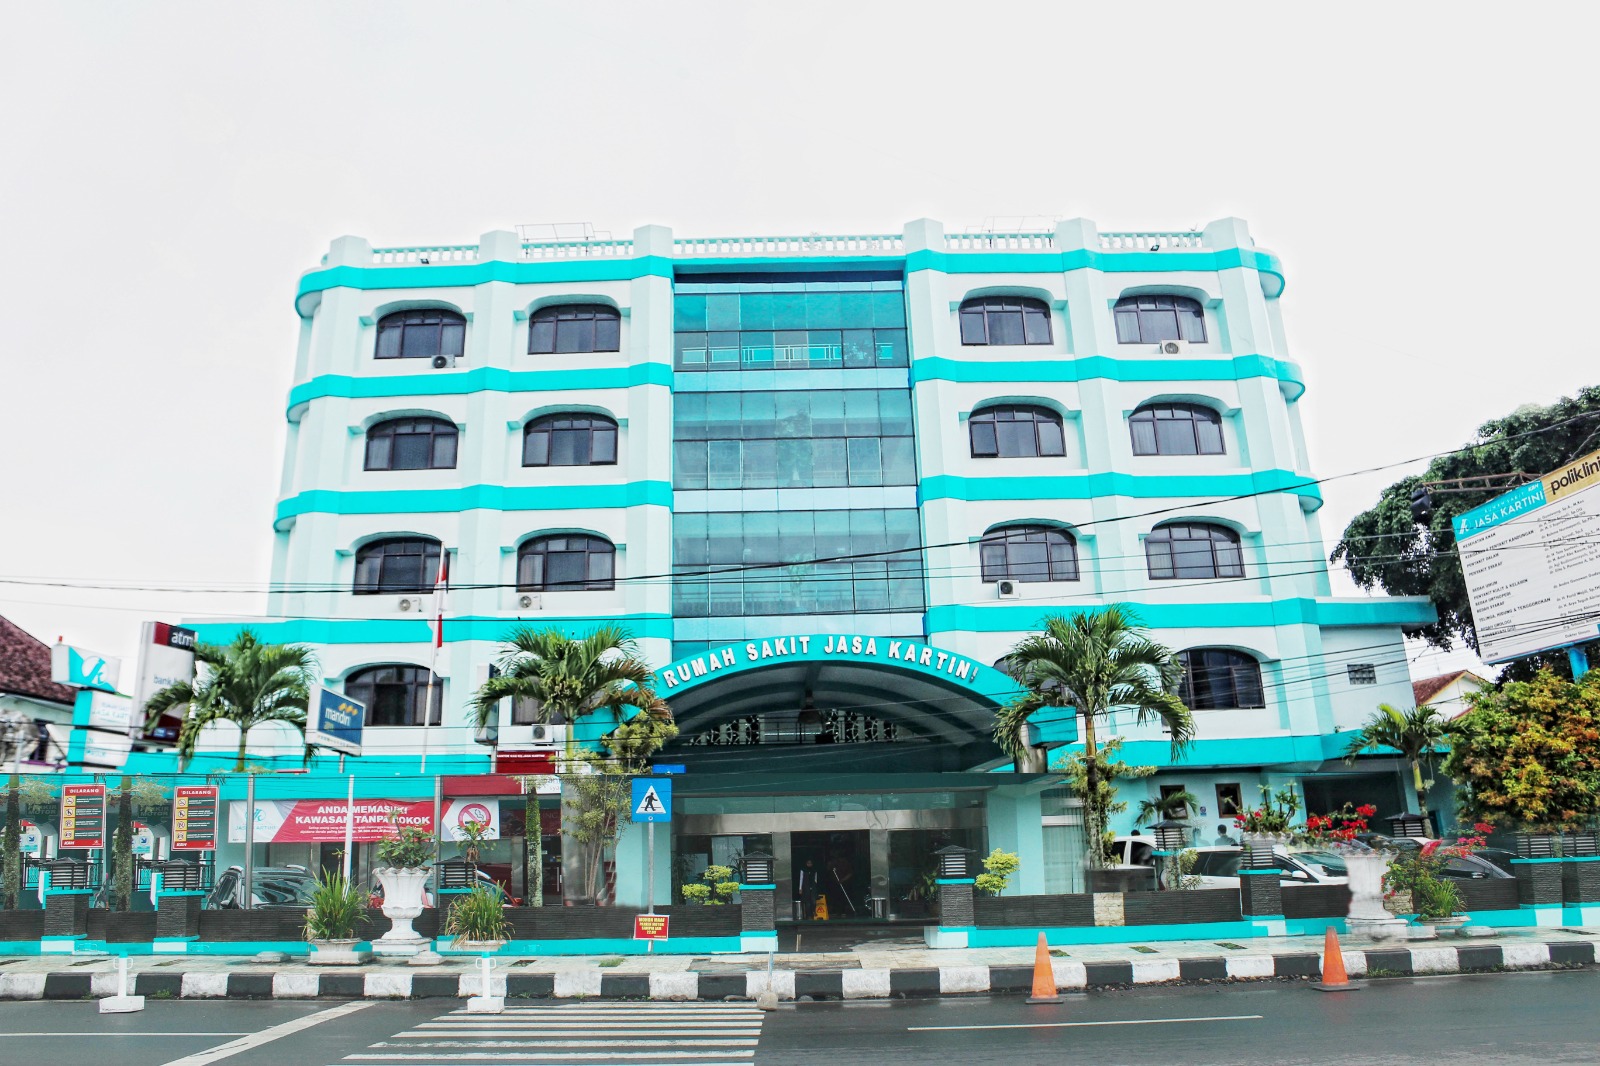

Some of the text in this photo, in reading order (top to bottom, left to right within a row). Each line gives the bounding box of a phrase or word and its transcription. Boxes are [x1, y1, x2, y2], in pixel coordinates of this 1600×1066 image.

[1474, 513, 1498, 530] JASA
[1500, 490, 1544, 518] KARTINI
[172, 632, 194, 646] atm
[662, 636, 980, 689] RUMAH SAKIT JASA KARTINI
[317, 806, 348, 814] ANDA
